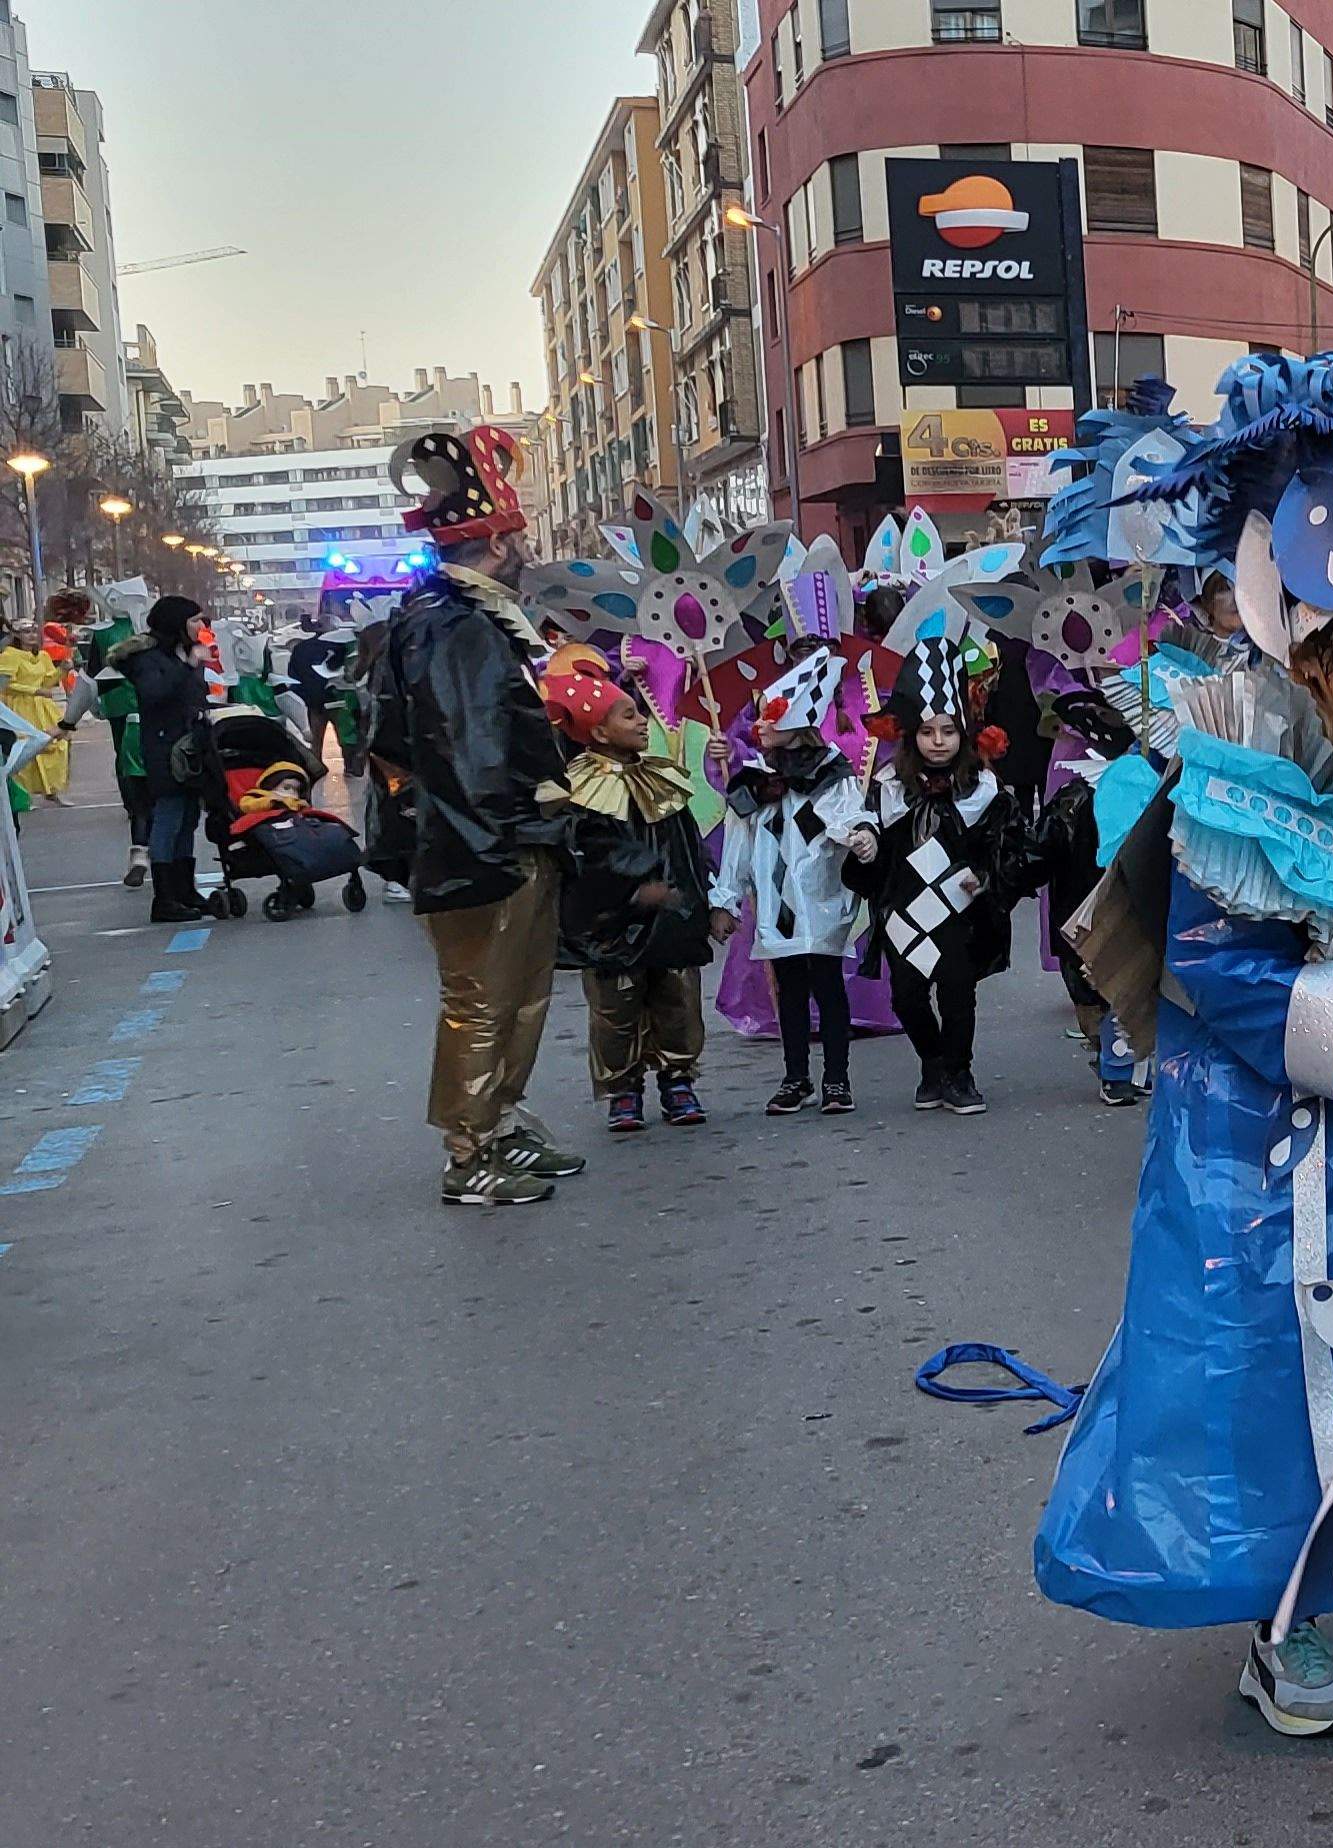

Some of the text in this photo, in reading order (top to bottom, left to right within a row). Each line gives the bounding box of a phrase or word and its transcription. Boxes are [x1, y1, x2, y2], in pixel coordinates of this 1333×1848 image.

[922, 259, 1034, 279] REPSOL
[1029, 418, 1048, 433] ES
[907, 414, 1001, 458] 4 Cts.
[1011, 437, 1068, 452] GRATIS
